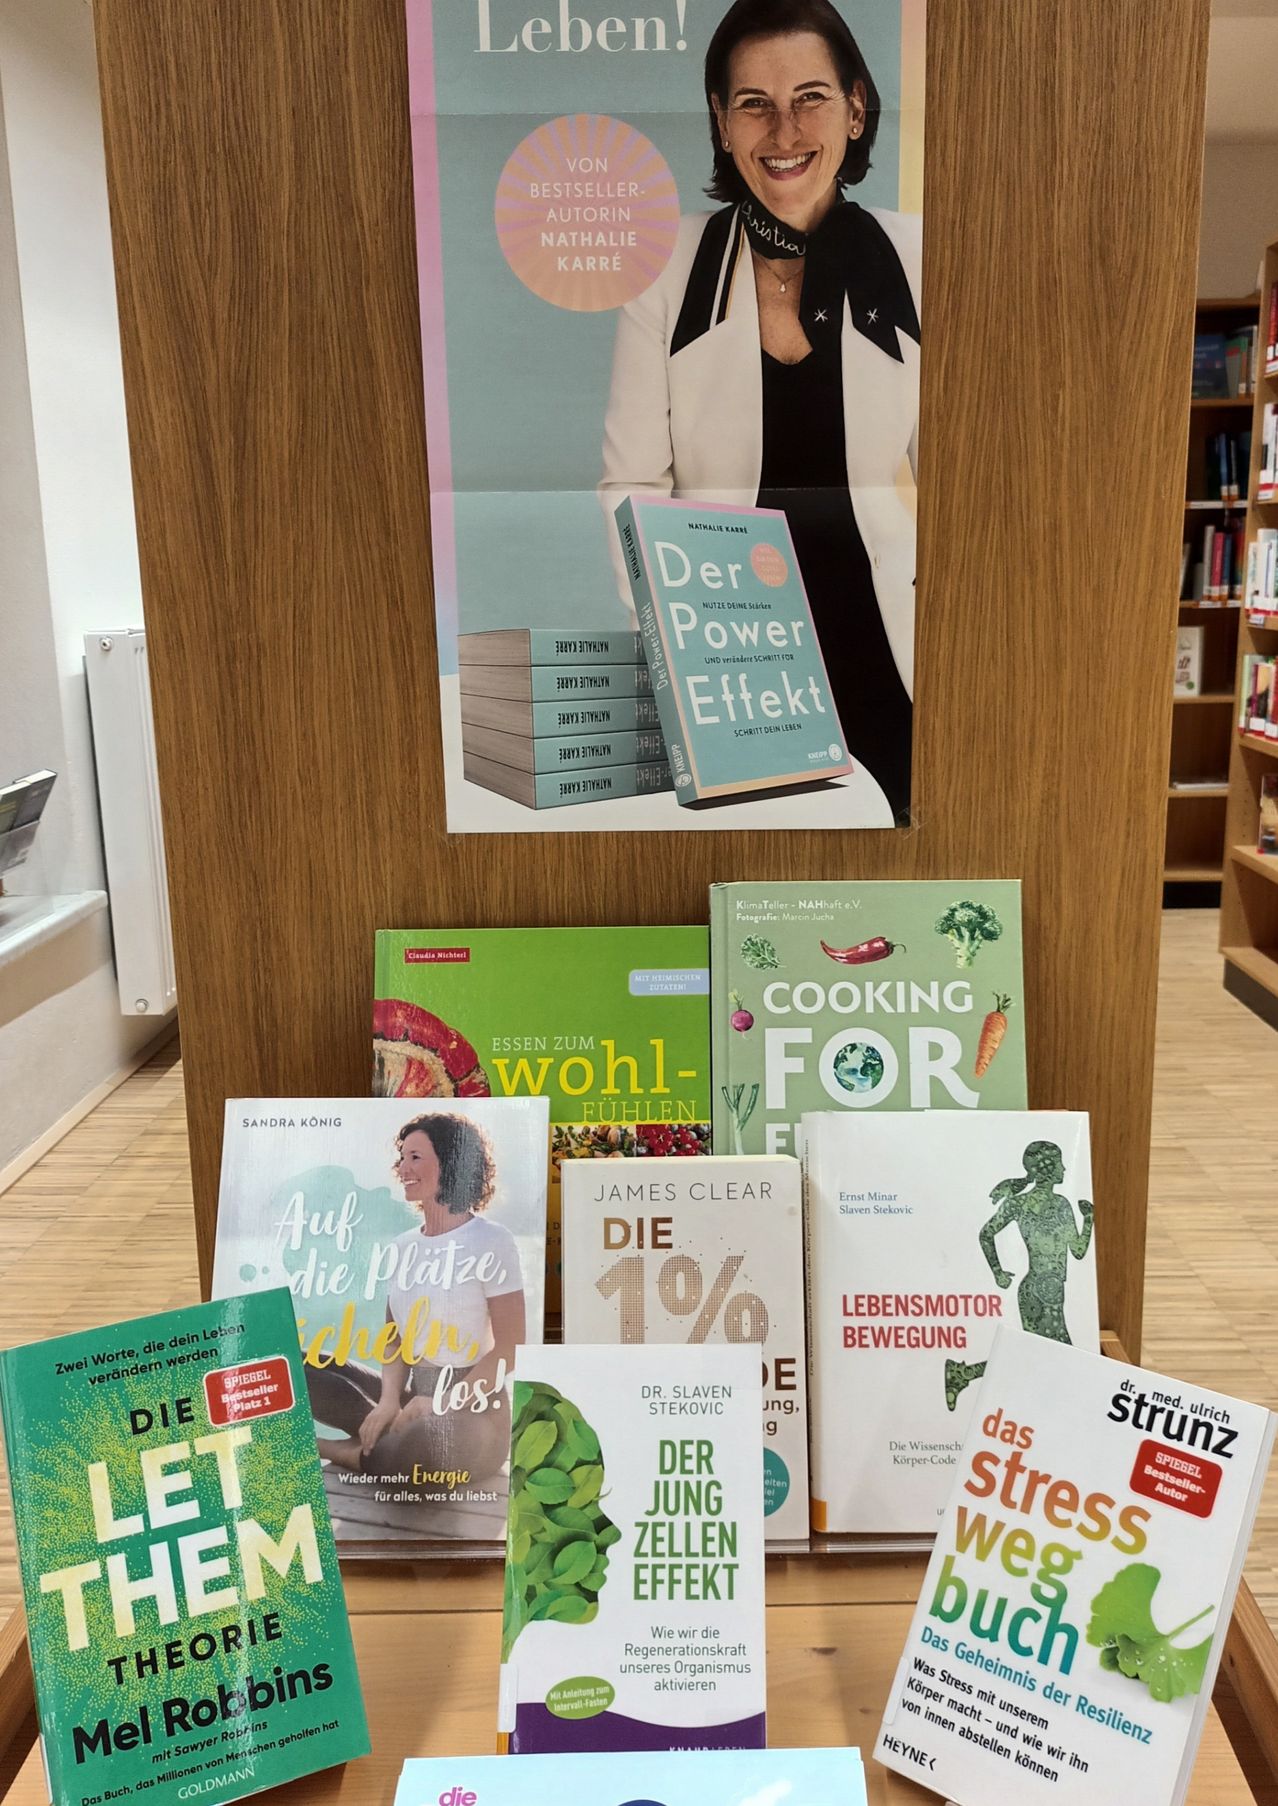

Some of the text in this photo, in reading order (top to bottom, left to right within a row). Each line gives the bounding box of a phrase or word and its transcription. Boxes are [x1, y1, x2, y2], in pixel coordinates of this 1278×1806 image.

[473, 0, 688, 53] Leben!
[566, 157, 608, 173] VON
[530, 182, 646, 199] BESTSELLER-
[546, 207, 631, 223] AUTORIN
[540, 231, 637, 248] NATHALIE
[557, 253, 622, 272] KARRÉ
[688, 522, 723, 532] NATHALIE
[654, 540, 742, 590] Der
[702, 602, 726, 610] NUTZE
[727, 602, 748, 610] DEINE
[668, 601, 804, 650] Power
[579, 641, 609, 653] NATHALIE
[753, 654, 780, 662] SCHRITT
[579, 676, 610, 688] NATHALIE
[685, 671, 826, 725] Effekt
[734, 723, 802, 737] SCHRITT DEIN LEBEN
[582, 778, 612, 792] NATHALIE
[736, 899, 862, 910] KlimaTeller NAHhaft e.V.
[736, 912, 834, 923] Fotografie: Marcin Jucha
[408, 951, 435, 959] Claudia
[649, 983, 687, 991] ZUTATEN!
[651, 974, 701, 982] HEIMISCHEN
[763, 980, 973, 1014] COOKING
[492, 1036, 595, 1051] ESSEN ZUM
[492, 1039, 697, 1096] wohl-
[765, 1026, 980, 1109] FOR
[242, 1116, 342, 1128] SANDRA KÖNIG
[582, 1098, 696, 1123] FÜHLEN
[594, 1181, 773, 1202] JAMES CLEAR
[839, 1192, 898, 1201] Ernst Minar
[269, 1191, 363, 1252] Auf
[839, 1205, 914, 1214] Slaven Stekovic
[603, 1217, 673, 1250] DIE
[291, 1239, 507, 1301] die Plätze,
[842, 1294, 1003, 1317] LEBENSMOTOR
[55, 1322, 245, 1375] Zwei Worte, die dein Leben
[843, 1326, 967, 1349] BEWEGUNG
[88, 1346, 219, 1386] verändern werden
[224, 1369, 271, 1389] SPIEGEL
[432, 1358, 507, 1416] los!
[221, 1382, 279, 1404] Bestseller
[641, 1385, 732, 1398] DR. SLAVEN
[1120, 1379, 1231, 1424] dr. med. ulrich
[130, 1397, 195, 1436] DIE
[232, 1396, 271, 1414] Platz 1
[649, 1402, 724, 1415] STEKOVIC
[982, 1407, 1035, 1450] das
[1107, 1392, 1239, 1459] strunz
[659, 1439, 715, 1475] DER
[889, 1441, 964, 1451] Die Wissensch
[893, 1454, 957, 1467] Körper-Code
[1155, 1451, 1202, 1479] SPIEGEL
[88, 1426, 252, 1544] LET
[338, 1464, 472, 1489] Wieder mehr Energie
[1143, 1464, 1207, 1495] Bestseller-
[374, 1490, 498, 1503] für alles, was du liebst
[644, 1480, 723, 1517] JUNG
[964, 1449, 1152, 1555] stress
[1154, 1482, 1188, 1503] Autor
[633, 1521, 737, 1558] ZELLEN
[955, 1504, 1084, 1608] weg
[39, 1503, 324, 1651] THEM
[633, 1563, 739, 1601] EFFEKT
[929, 1554, 1079, 1676] buch
[651, 1626, 720, 1639] Wie wir die
[107, 1612, 284, 1686] THEORIE
[624, 1643, 747, 1660] Regenerationskraft
[619, 1661, 751, 1677] unseres Organismus
[549, 1685, 610, 1700] Mit Anleitung zum
[654, 1679, 717, 1692] aktivieren
[913, 1656, 1049, 1730] Was Stress mit unserem
[921, 1625, 1153, 1745] Das Geheimnis der Resilienz
[72, 1663, 334, 1765] Mel Robbins
[553, 1696, 608, 1712] Intervall-Fasten
[907, 1676, 1089, 1773] Körper macht und wie wir ihn
[151, 1719, 268, 1764] mit Sawyer Robbins
[902, 1698, 1059, 1782] von innen abstellen können
[81, 1719, 340, 1806] Das Buch, das Millionen von Menschen geholfen hat
[177, 1766, 256, 1800] GOLDMANN
